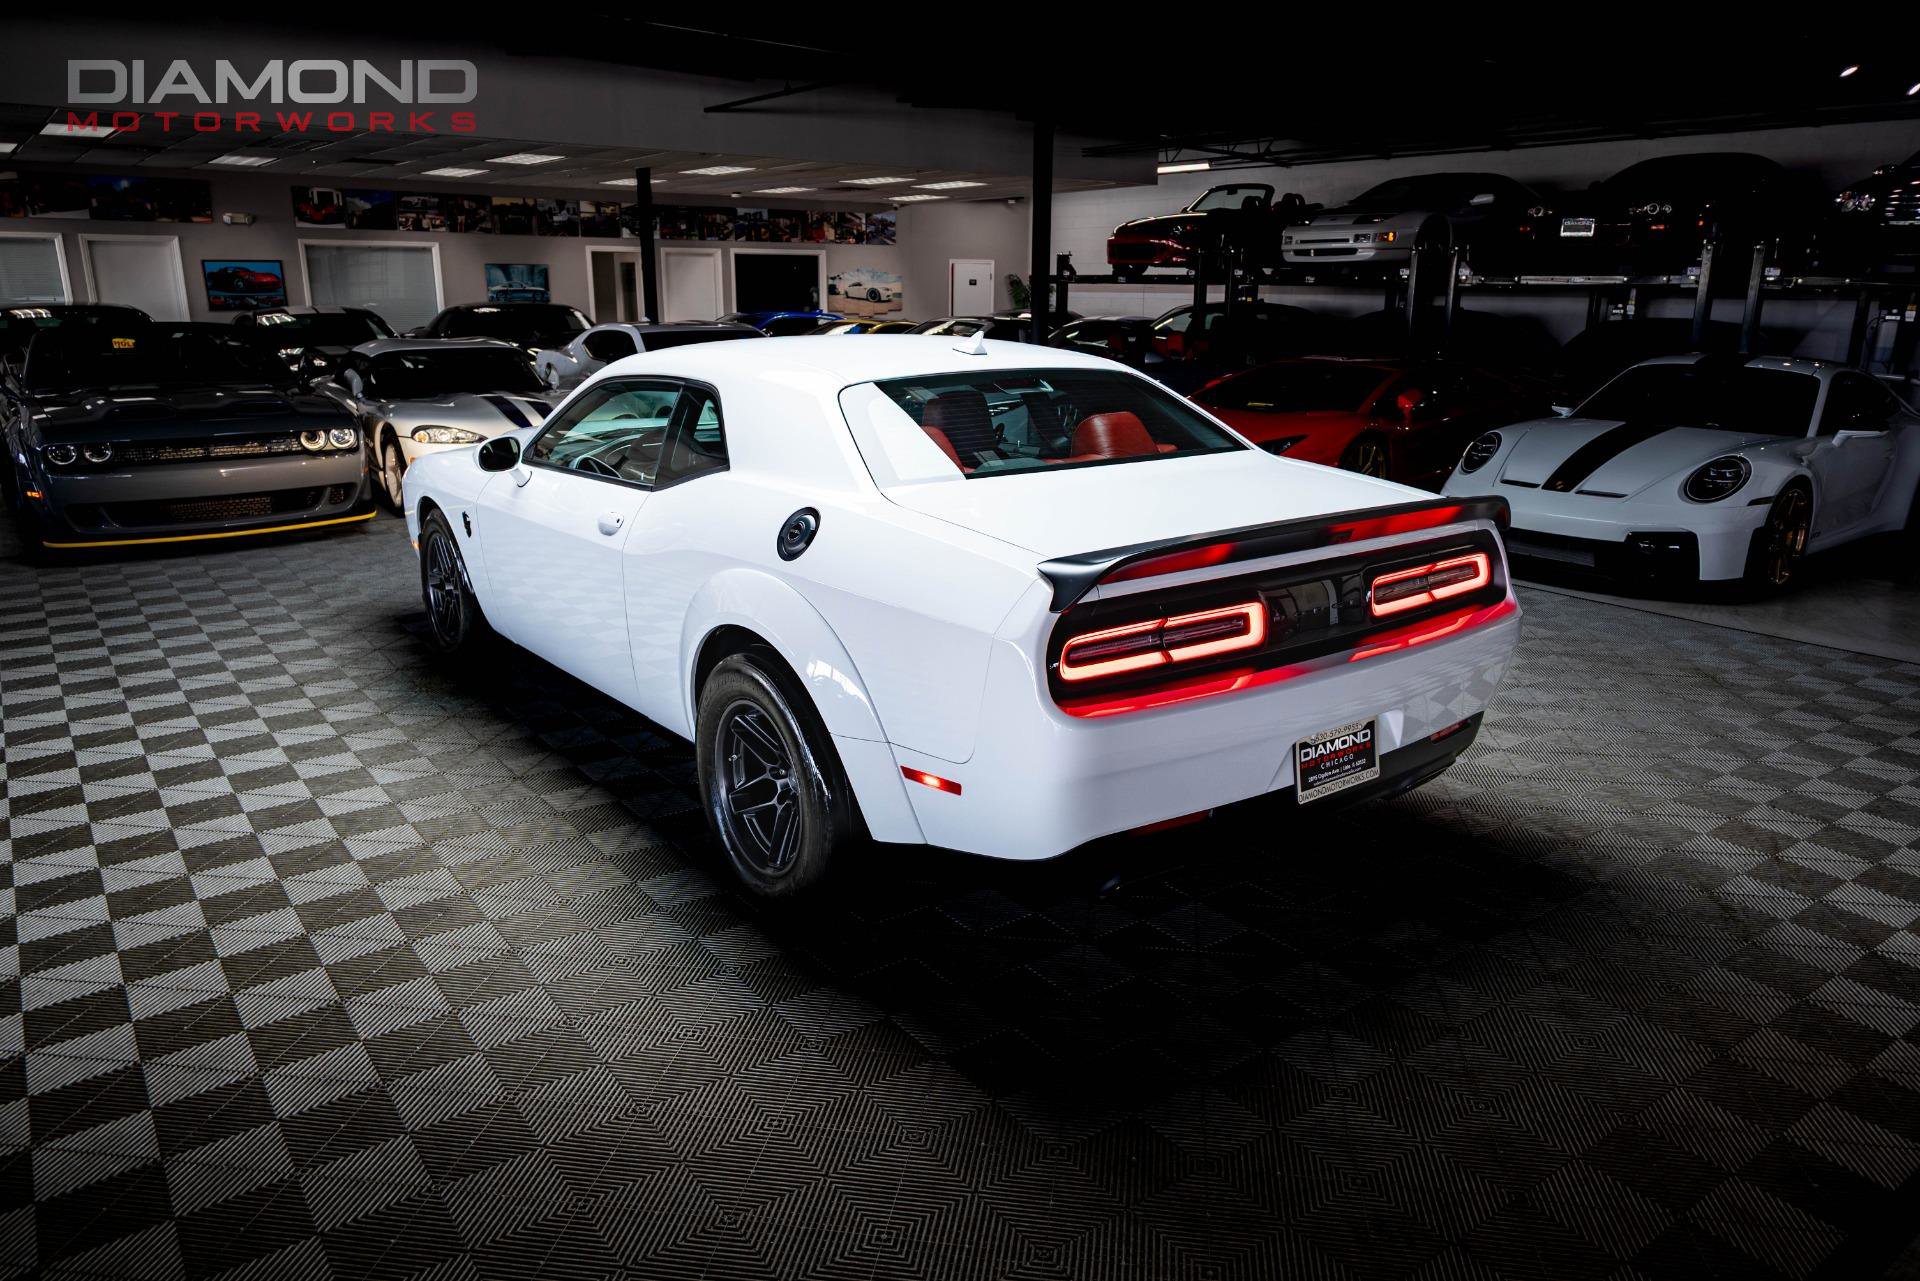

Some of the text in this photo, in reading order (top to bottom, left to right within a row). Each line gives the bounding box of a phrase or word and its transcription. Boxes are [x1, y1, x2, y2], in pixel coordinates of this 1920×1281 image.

[1300, 728, 1371, 763] DIAMOND
[1320, 753, 1354, 770] CHICAGO
[1298, 768, 1380, 803] DIAMONDMOTORWORKS.COM
